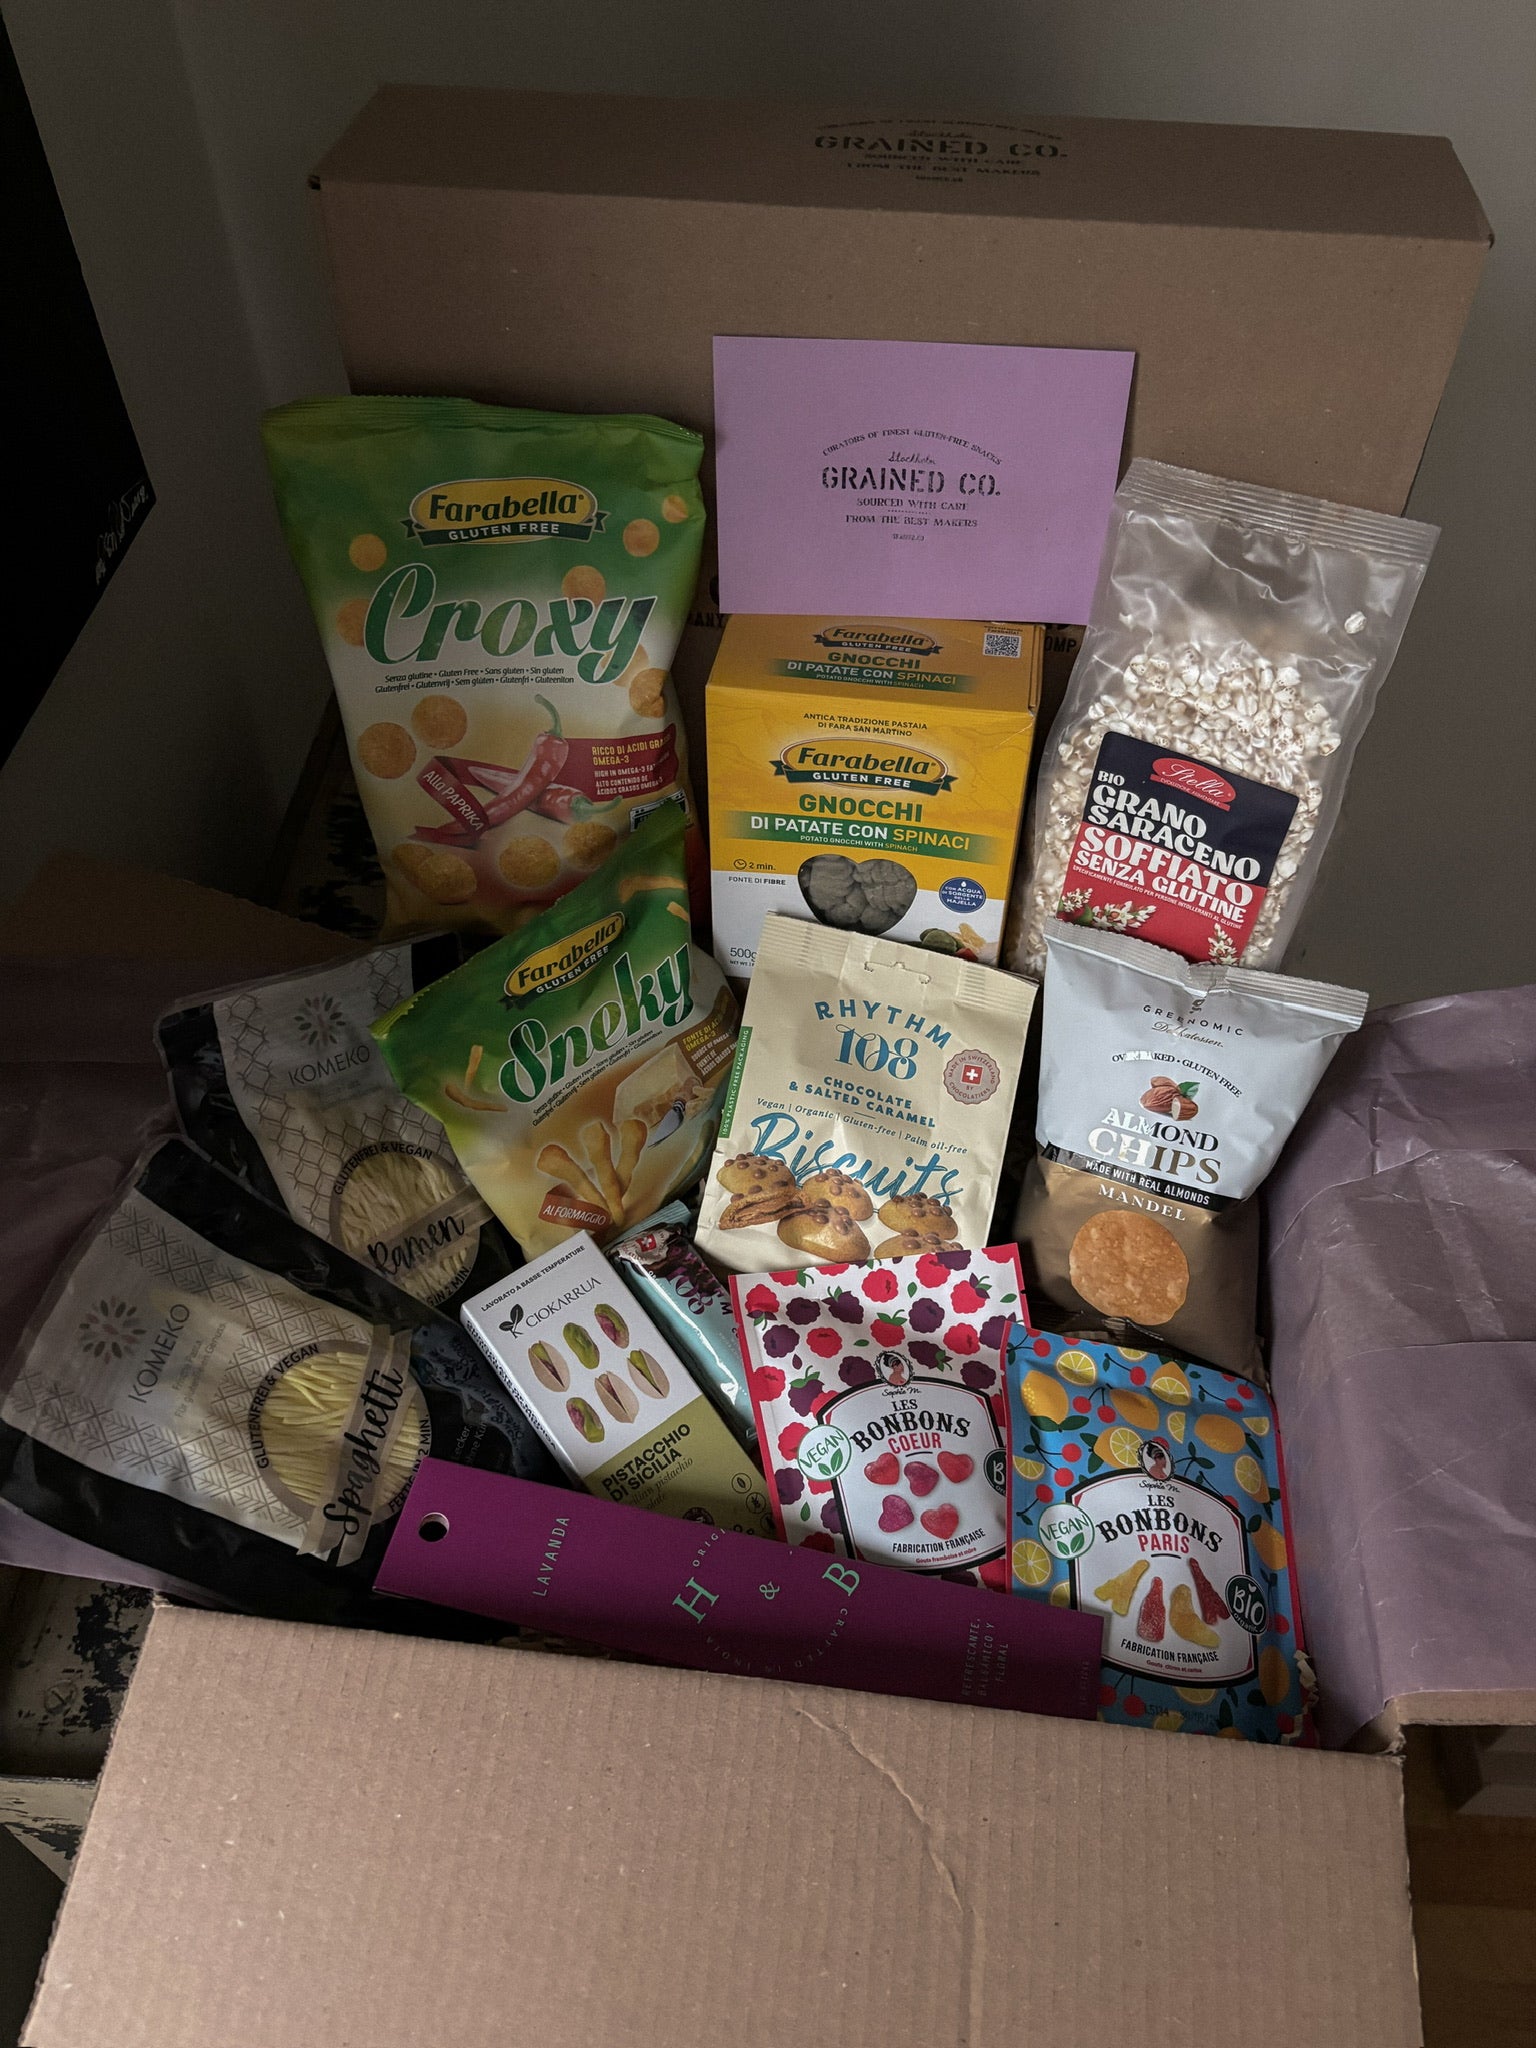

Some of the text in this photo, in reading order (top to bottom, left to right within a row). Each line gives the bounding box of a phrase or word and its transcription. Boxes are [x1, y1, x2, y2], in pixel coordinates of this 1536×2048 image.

[815, 135, 1068, 158] GRAINED CO.
[822, 429, 1003, 466] CURATORS FINEST GLUTEN-FREE SNACKS
[822, 466, 1001, 497] GRAINED CO.
[845, 514, 978, 528] FROM THE BEST MAKERS
[856, 497, 969, 511] SOURCED WITH CARE
[448, 522, 561, 541] GLUTEN FREE
[364, 562, 658, 686] Croxy
[827, 652, 921, 669] GNOCCHI
[841, 641, 912, 653] GLUTEN FREE
[375, 678, 471, 694] Glutenfrei Glutenvrij Sem
[385, 667, 564, 683] Senza glutine Gluten Free Sans gluten Sin gluten
[787, 660, 957, 685] DI PATATE CON SPINACI
[803, 712, 928, 731] ANTICA TRADIZIONE PASTAIA
[818, 721, 913, 737] DI FARA SAN MARTINO
[592, 741, 648, 756] RICCO DI ACIDI
[592, 755, 631, 766] OMEGA-3
[594, 765, 646, 778] HIGH OMEGA-3
[812, 771, 912, 789] GLUTEN FREE
[1097, 769, 1126, 787] BIO
[1161, 763, 1225, 798] Stella
[441, 786, 485, 832] PAPRIKA
[799, 793, 923, 823] GNOCCHI
[1092, 784, 1208, 839] GRANO
[750, 815, 971, 851] DI PATATE CON SPINACI
[799, 835, 919, 853] POTATO GNOCCHI WITH SPINACH
[1087, 804, 1262, 882] SARACENO
[728, 876, 787, 886] FONTE FIBRE
[756, 862, 777, 871] min.
[1079, 826, 1254, 908] SOFFIATO
[1072, 864, 1214, 920] SPECIFICAMENTE FORMULATO INTOLLERANTI
[1074, 850, 1247, 924] SENZA GLUTINE
[535, 944, 611, 995] GLUTEN FREE
[498, 942, 695, 1104] Sneky
[815, 999, 952, 1050] RHYTHM
[1142, 1004, 1244, 1036] GREENOMIC
[288, 1044, 371, 1086] KOMEKO
[835, 1024, 919, 1081] 108
[727, 1071, 743, 1121] PLASTIC-FREE
[735, 1029, 749, 1070] PACKAGING
[823, 1076, 912, 1110] CHOCOLATE
[1181, 1058, 1243, 1099] GLUTEN FREE
[789, 1080, 936, 1128] & SALTED CARAMEL
[756, 1097, 969, 1156] Vegan Organic Gluten-free Palm oil-free
[1101, 1107, 1219, 1153] ALMOND
[333, 1142, 434, 1196] GLUTENFREI & VEGAN
[750, 1112, 964, 1207] Biscuits
[1088, 1127, 1222, 1185] CHIPS
[1085, 1160, 1210, 1206] MADE WITH REAL ALMONDS
[552, 1206, 608, 1227] FORMAGGIO
[1098, 1184, 1186, 1222] MANDEL
[367, 1215, 466, 1277] Ramen
[481, 1244, 586, 1312] LAVORATO BASSE TEMPERATURE
[525, 1276, 602, 1329] CIOKARRUA
[128, 1304, 191, 1404] KOMEKO
[248, 1343, 320, 1470] GLUTENFREI & VEGAN
[891, 1398, 918, 1412] LES
[420, 1413, 431, 1445] MIN.
[849, 1411, 972, 1453] BONBONS
[888, 1432, 942, 1455] COEUR
[322, 1368, 405, 1537] Spaghetti
[602, 1424, 691, 1492] PISTACCHIO
[798, 1430, 845, 1469] VEGAN
[609, 1484, 629, 1501] DI
[627, 1448, 683, 1490] SICILIA
[1147, 1494, 1175, 1508] LES
[892, 1527, 986, 1554] FABRICATION FRANÇAISE
[1039, 1514, 1090, 1542] VEGAN
[1095, 1507, 1223, 1553] BONBONS
[1138, 1533, 1191, 1554] PARIS
[532, 1516, 571, 1598] LAVANDA
[673, 1561, 861, 1624] H & B
[1120, 1638, 1220, 1665] FABRICATION FRANÇAISE
